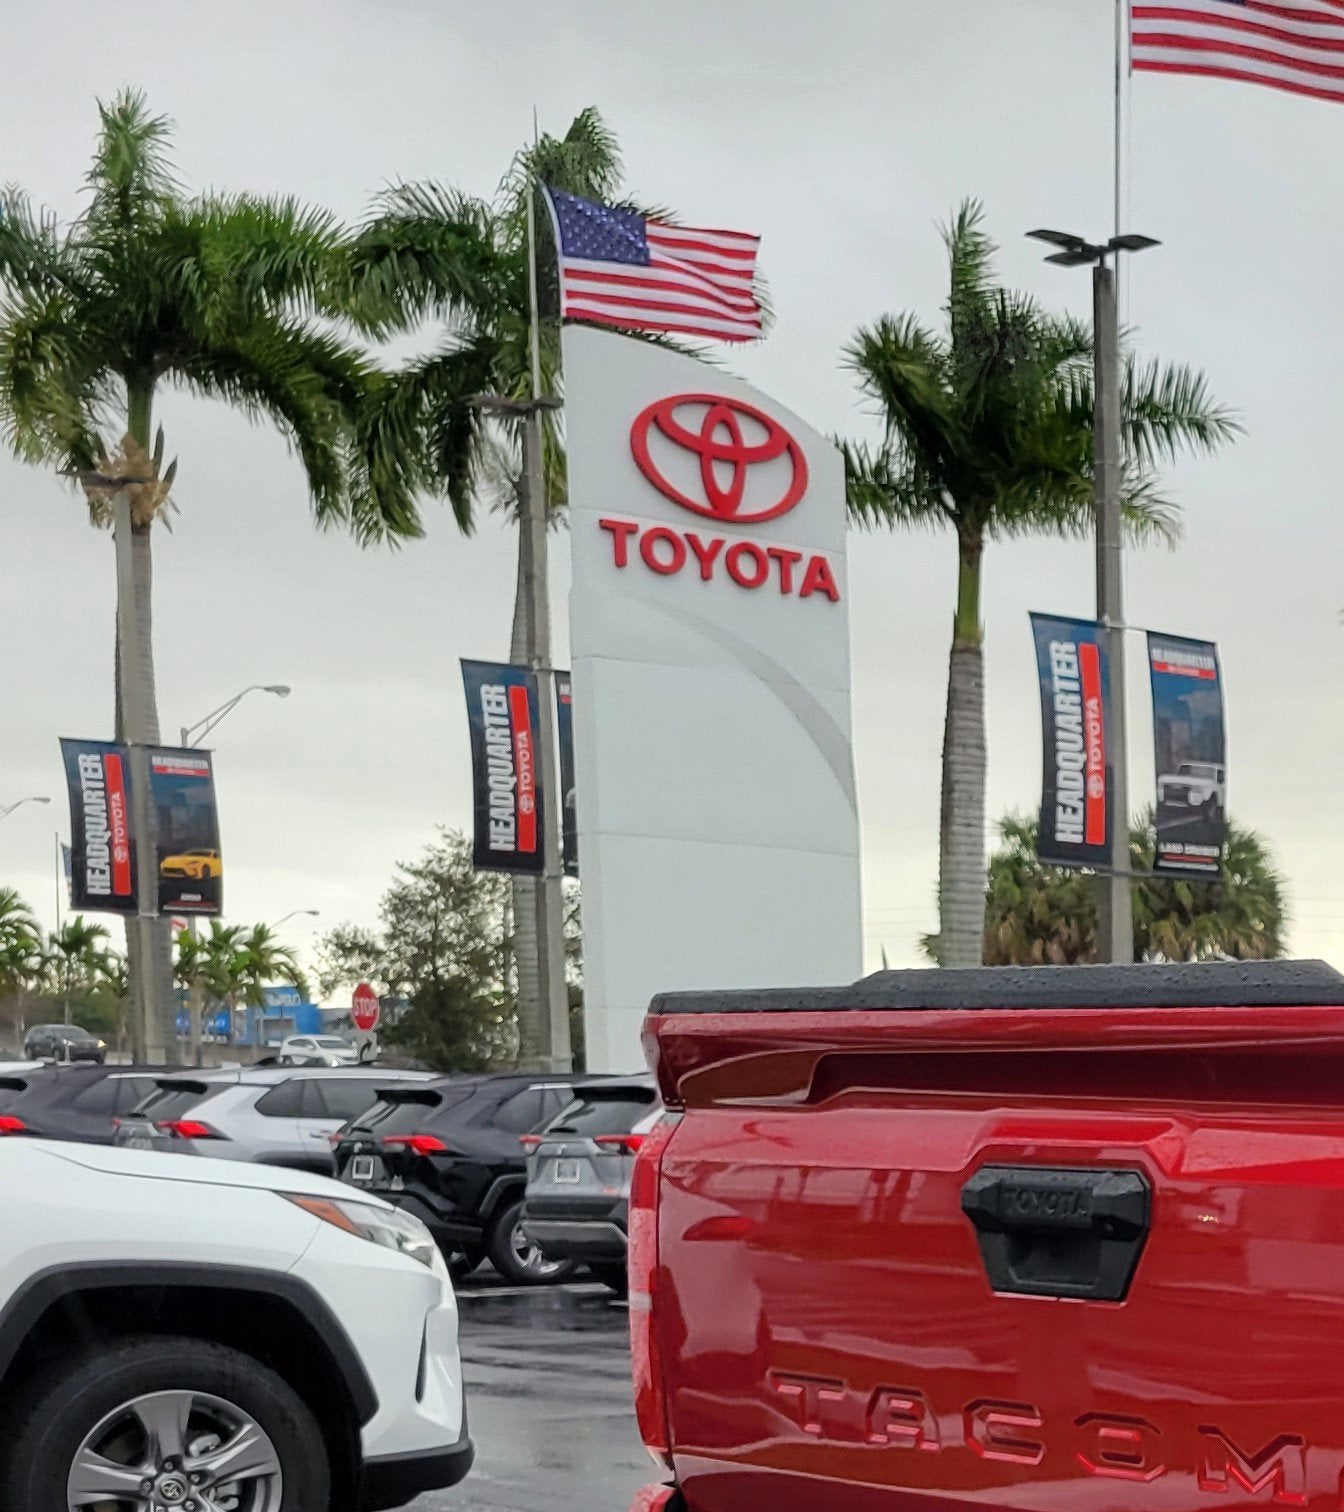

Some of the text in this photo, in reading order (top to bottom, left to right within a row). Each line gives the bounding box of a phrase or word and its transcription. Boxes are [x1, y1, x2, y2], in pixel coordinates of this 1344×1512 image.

[598, 518, 841, 603] TOYOTA
[480, 683, 517, 851] HEADQUARTER
[516, 731, 533, 791] TOYOTA
[1051, 639, 1087, 844] HEADQUARTER
[1085, 697, 1102, 772] TOYOTA
[78, 753, 112, 895] HEADQUARTER
[110, 792, 126, 844] TOYOTA
[353, 997, 379, 1018] STOP
[1002, 1187, 1089, 1218] TOYOTA
